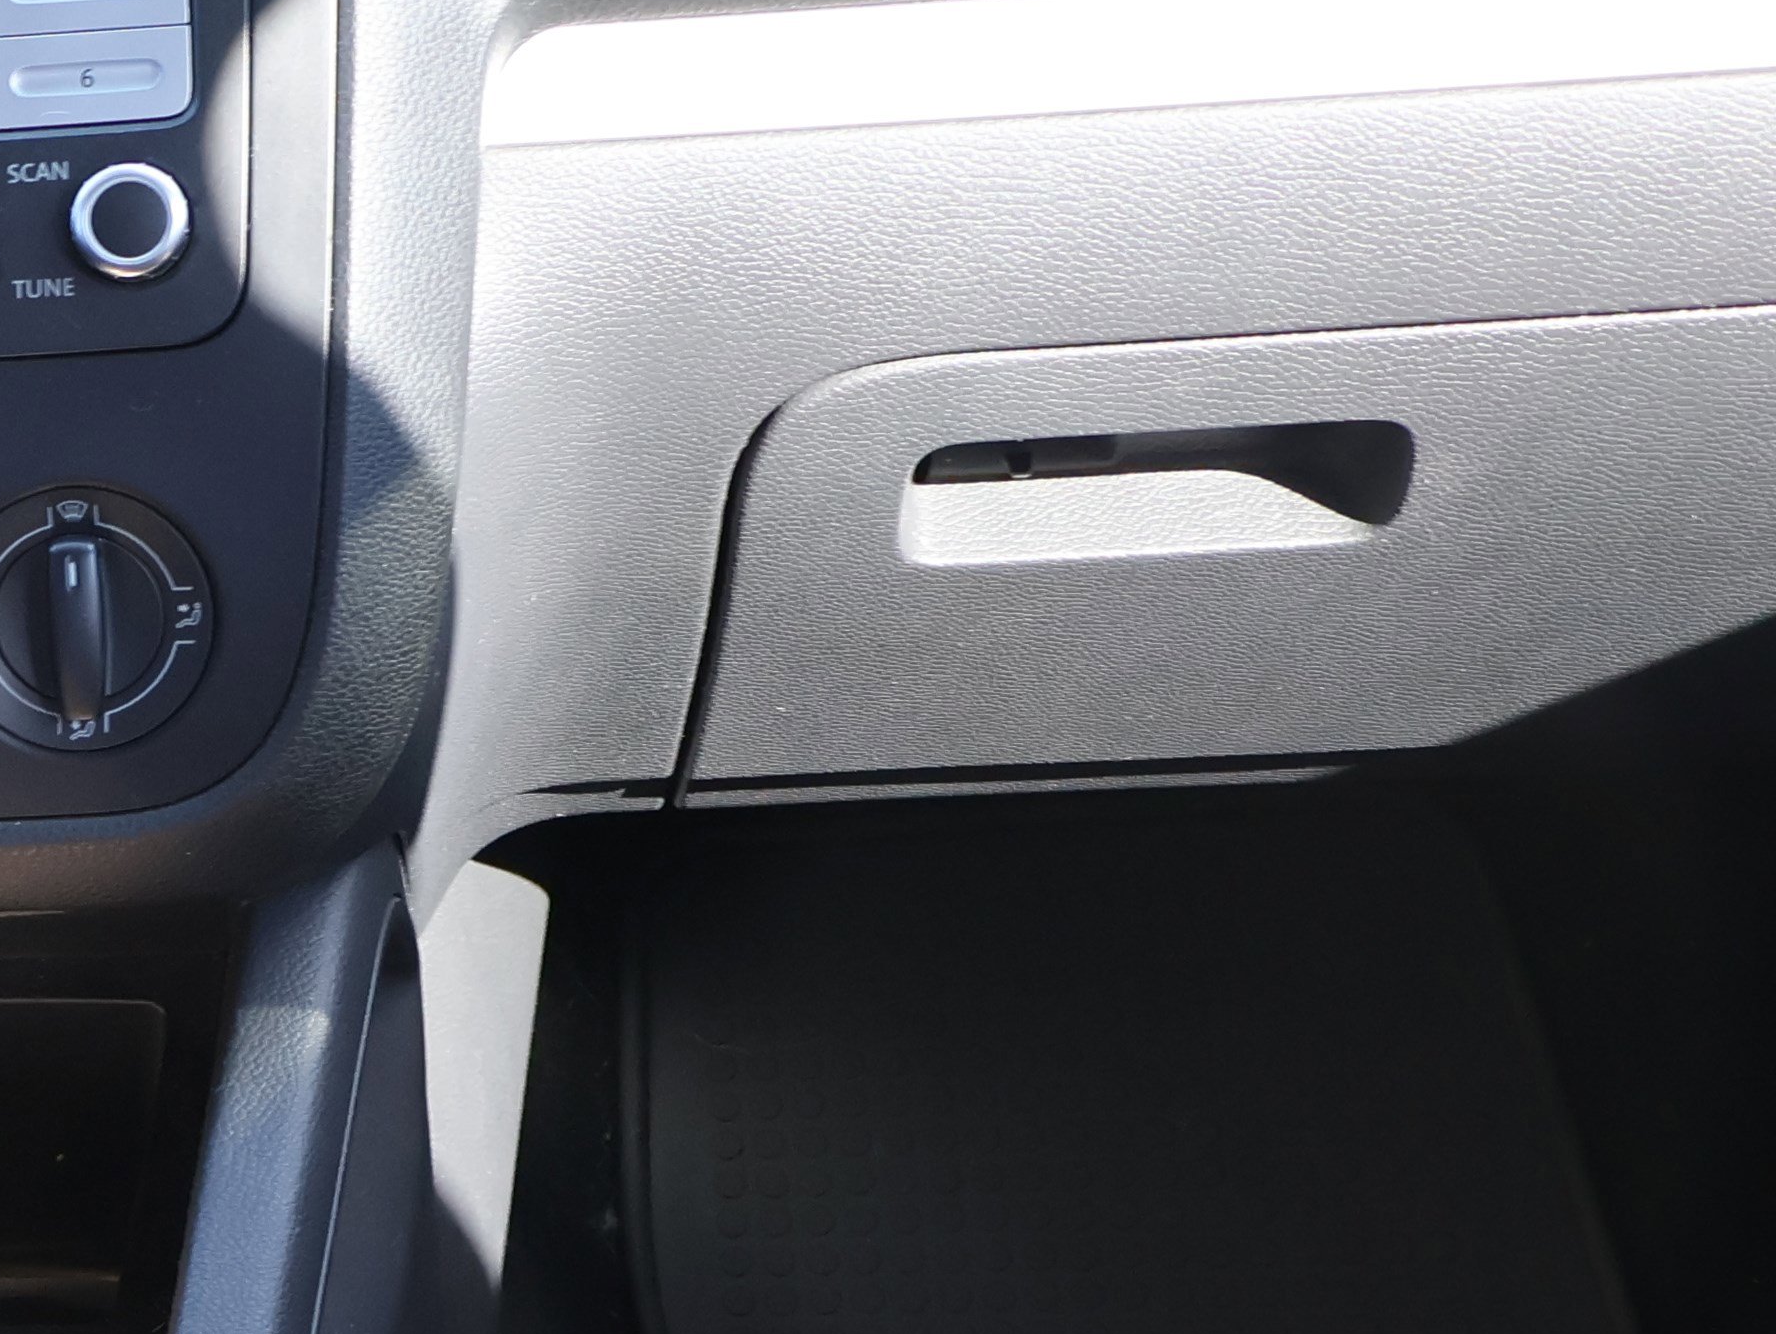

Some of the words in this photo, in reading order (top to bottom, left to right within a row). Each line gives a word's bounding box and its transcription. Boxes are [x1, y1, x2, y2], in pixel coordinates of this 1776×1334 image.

[80, 69, 94, 88] 6
[7, 161, 69, 184] SCAN
[12, 278, 76, 299] TUNE
